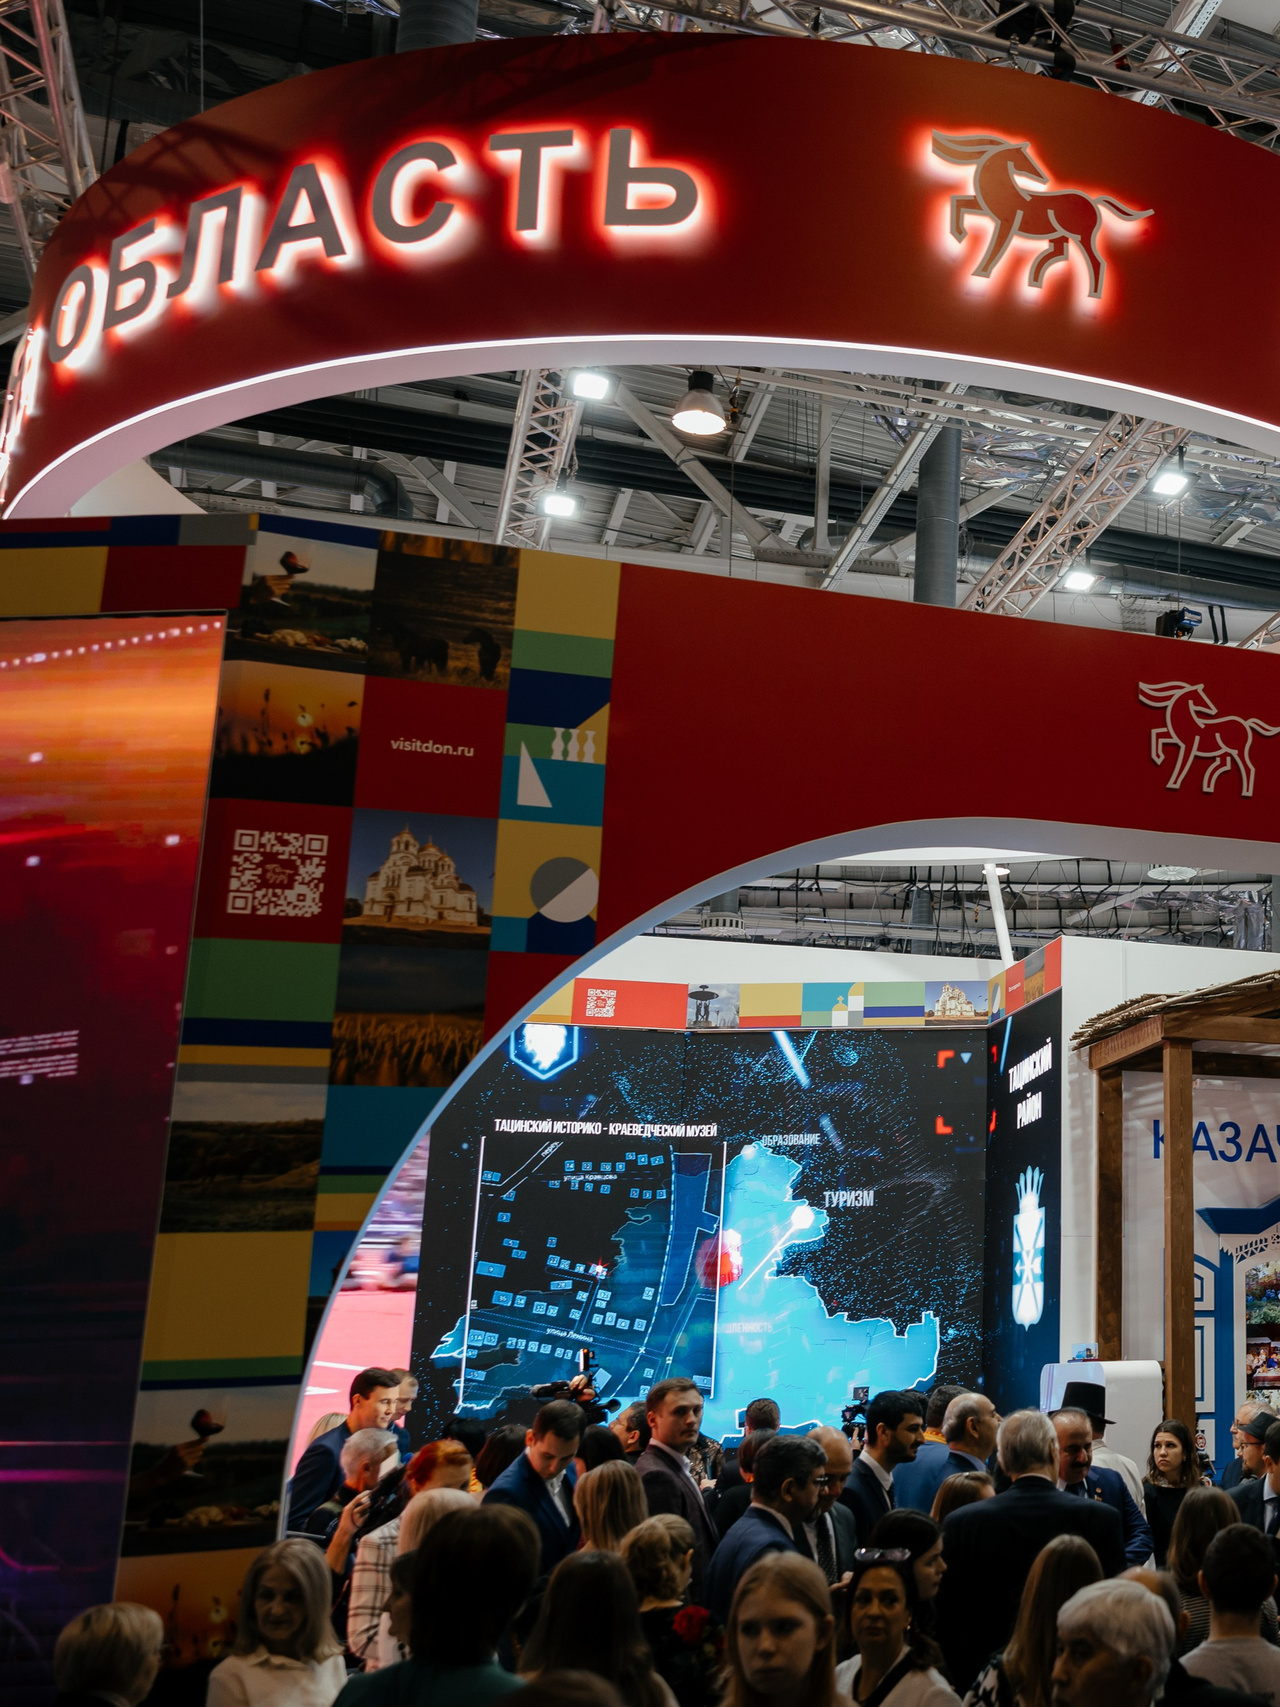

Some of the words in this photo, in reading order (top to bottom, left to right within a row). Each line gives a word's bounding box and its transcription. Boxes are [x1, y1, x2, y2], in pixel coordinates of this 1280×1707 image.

[48, 128, 700, 364] ОБЛАСТЬ
[390, 736, 475, 758] visitdon.ru
[1008, 1037, 1053, 1094] ТАЦИНСКИЙ
[1016, 1091, 1043, 1130] РАЙОН
[494, 1118, 552, 1134] ТАЦИНСКИЙ
[551, 1120, 602, 1135] ИСТОРИКО
[608, 1122, 686, 1138] КРАЕВЕДЧЕСКИЙ
[686, 1121, 718, 1138] МУЗЕЙ
[762, 1133, 821, 1146] ОБРАЗОВАНИЕ
[823, 1190, 875, 1208] ТУРИЗМ
